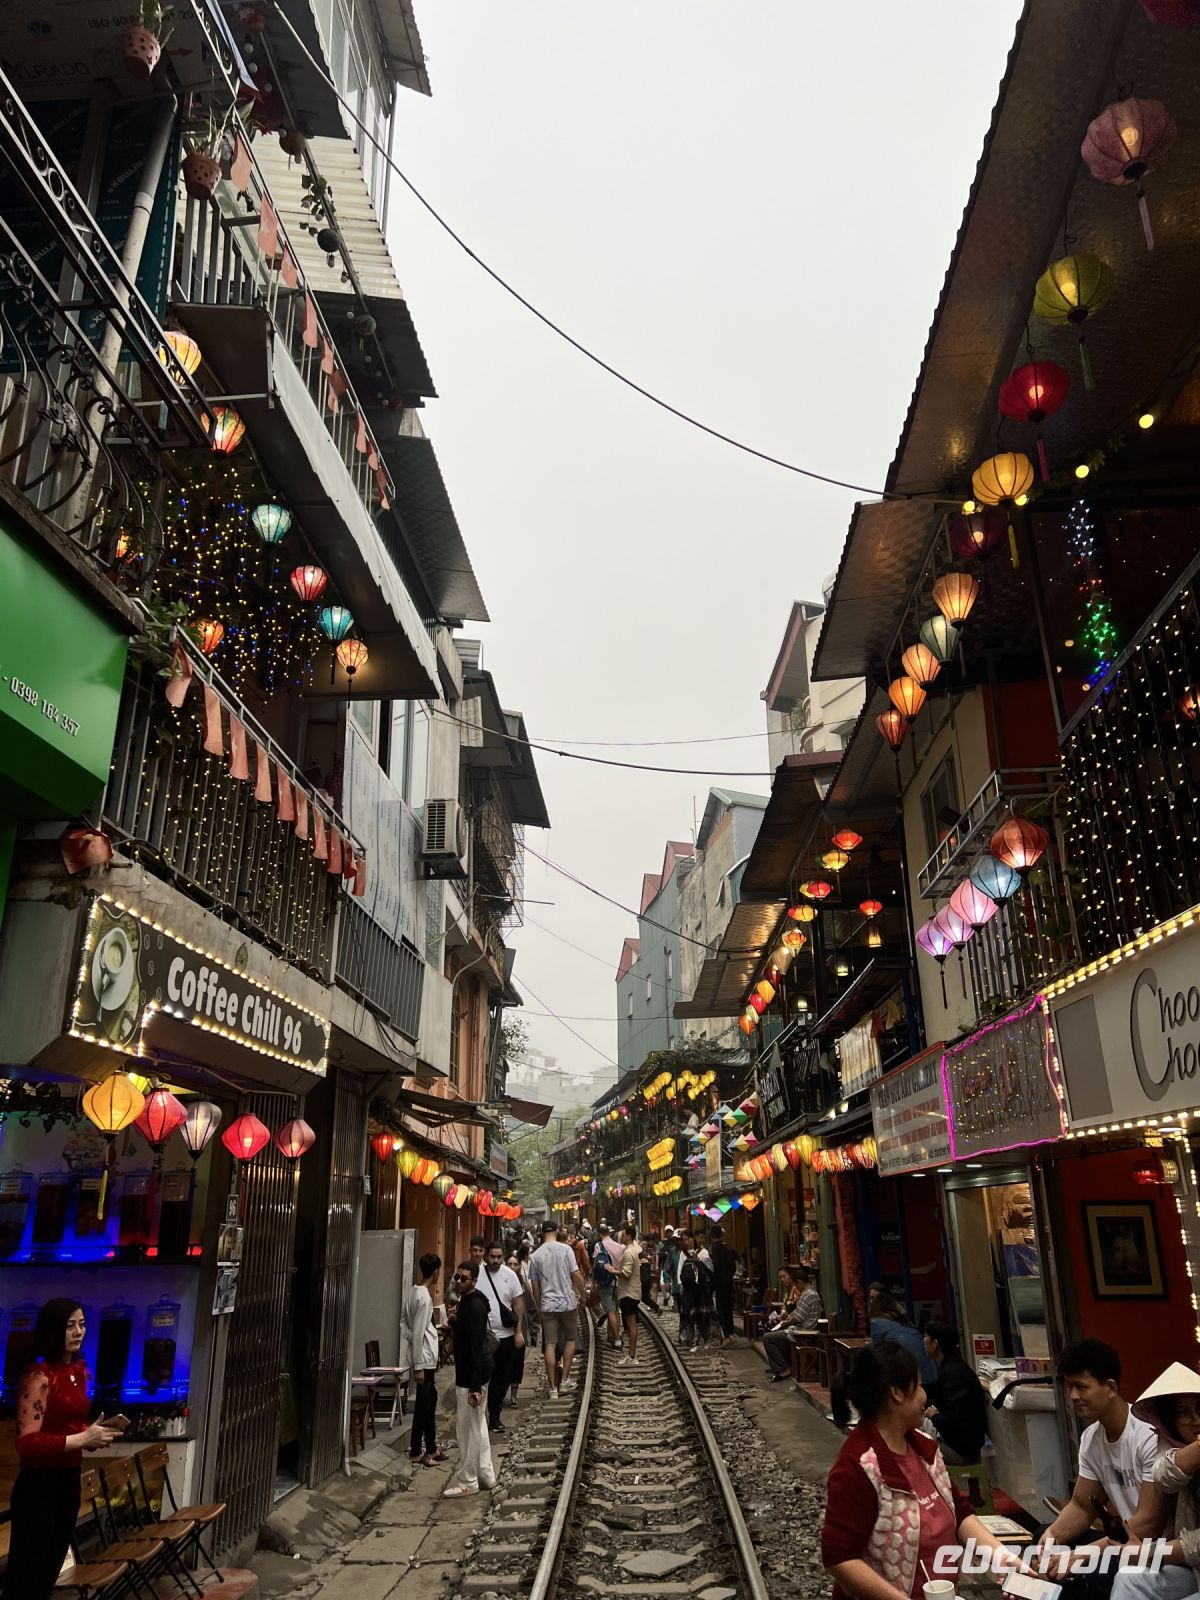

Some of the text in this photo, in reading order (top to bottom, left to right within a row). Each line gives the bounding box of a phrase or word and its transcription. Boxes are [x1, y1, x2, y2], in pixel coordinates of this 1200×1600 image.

[10, 676, 39, 706] 0398
[41, 699, 60, 724] 164
[60, 713, 81, 737] 357
[166, 956, 302, 1056] Coffee Chill 96
